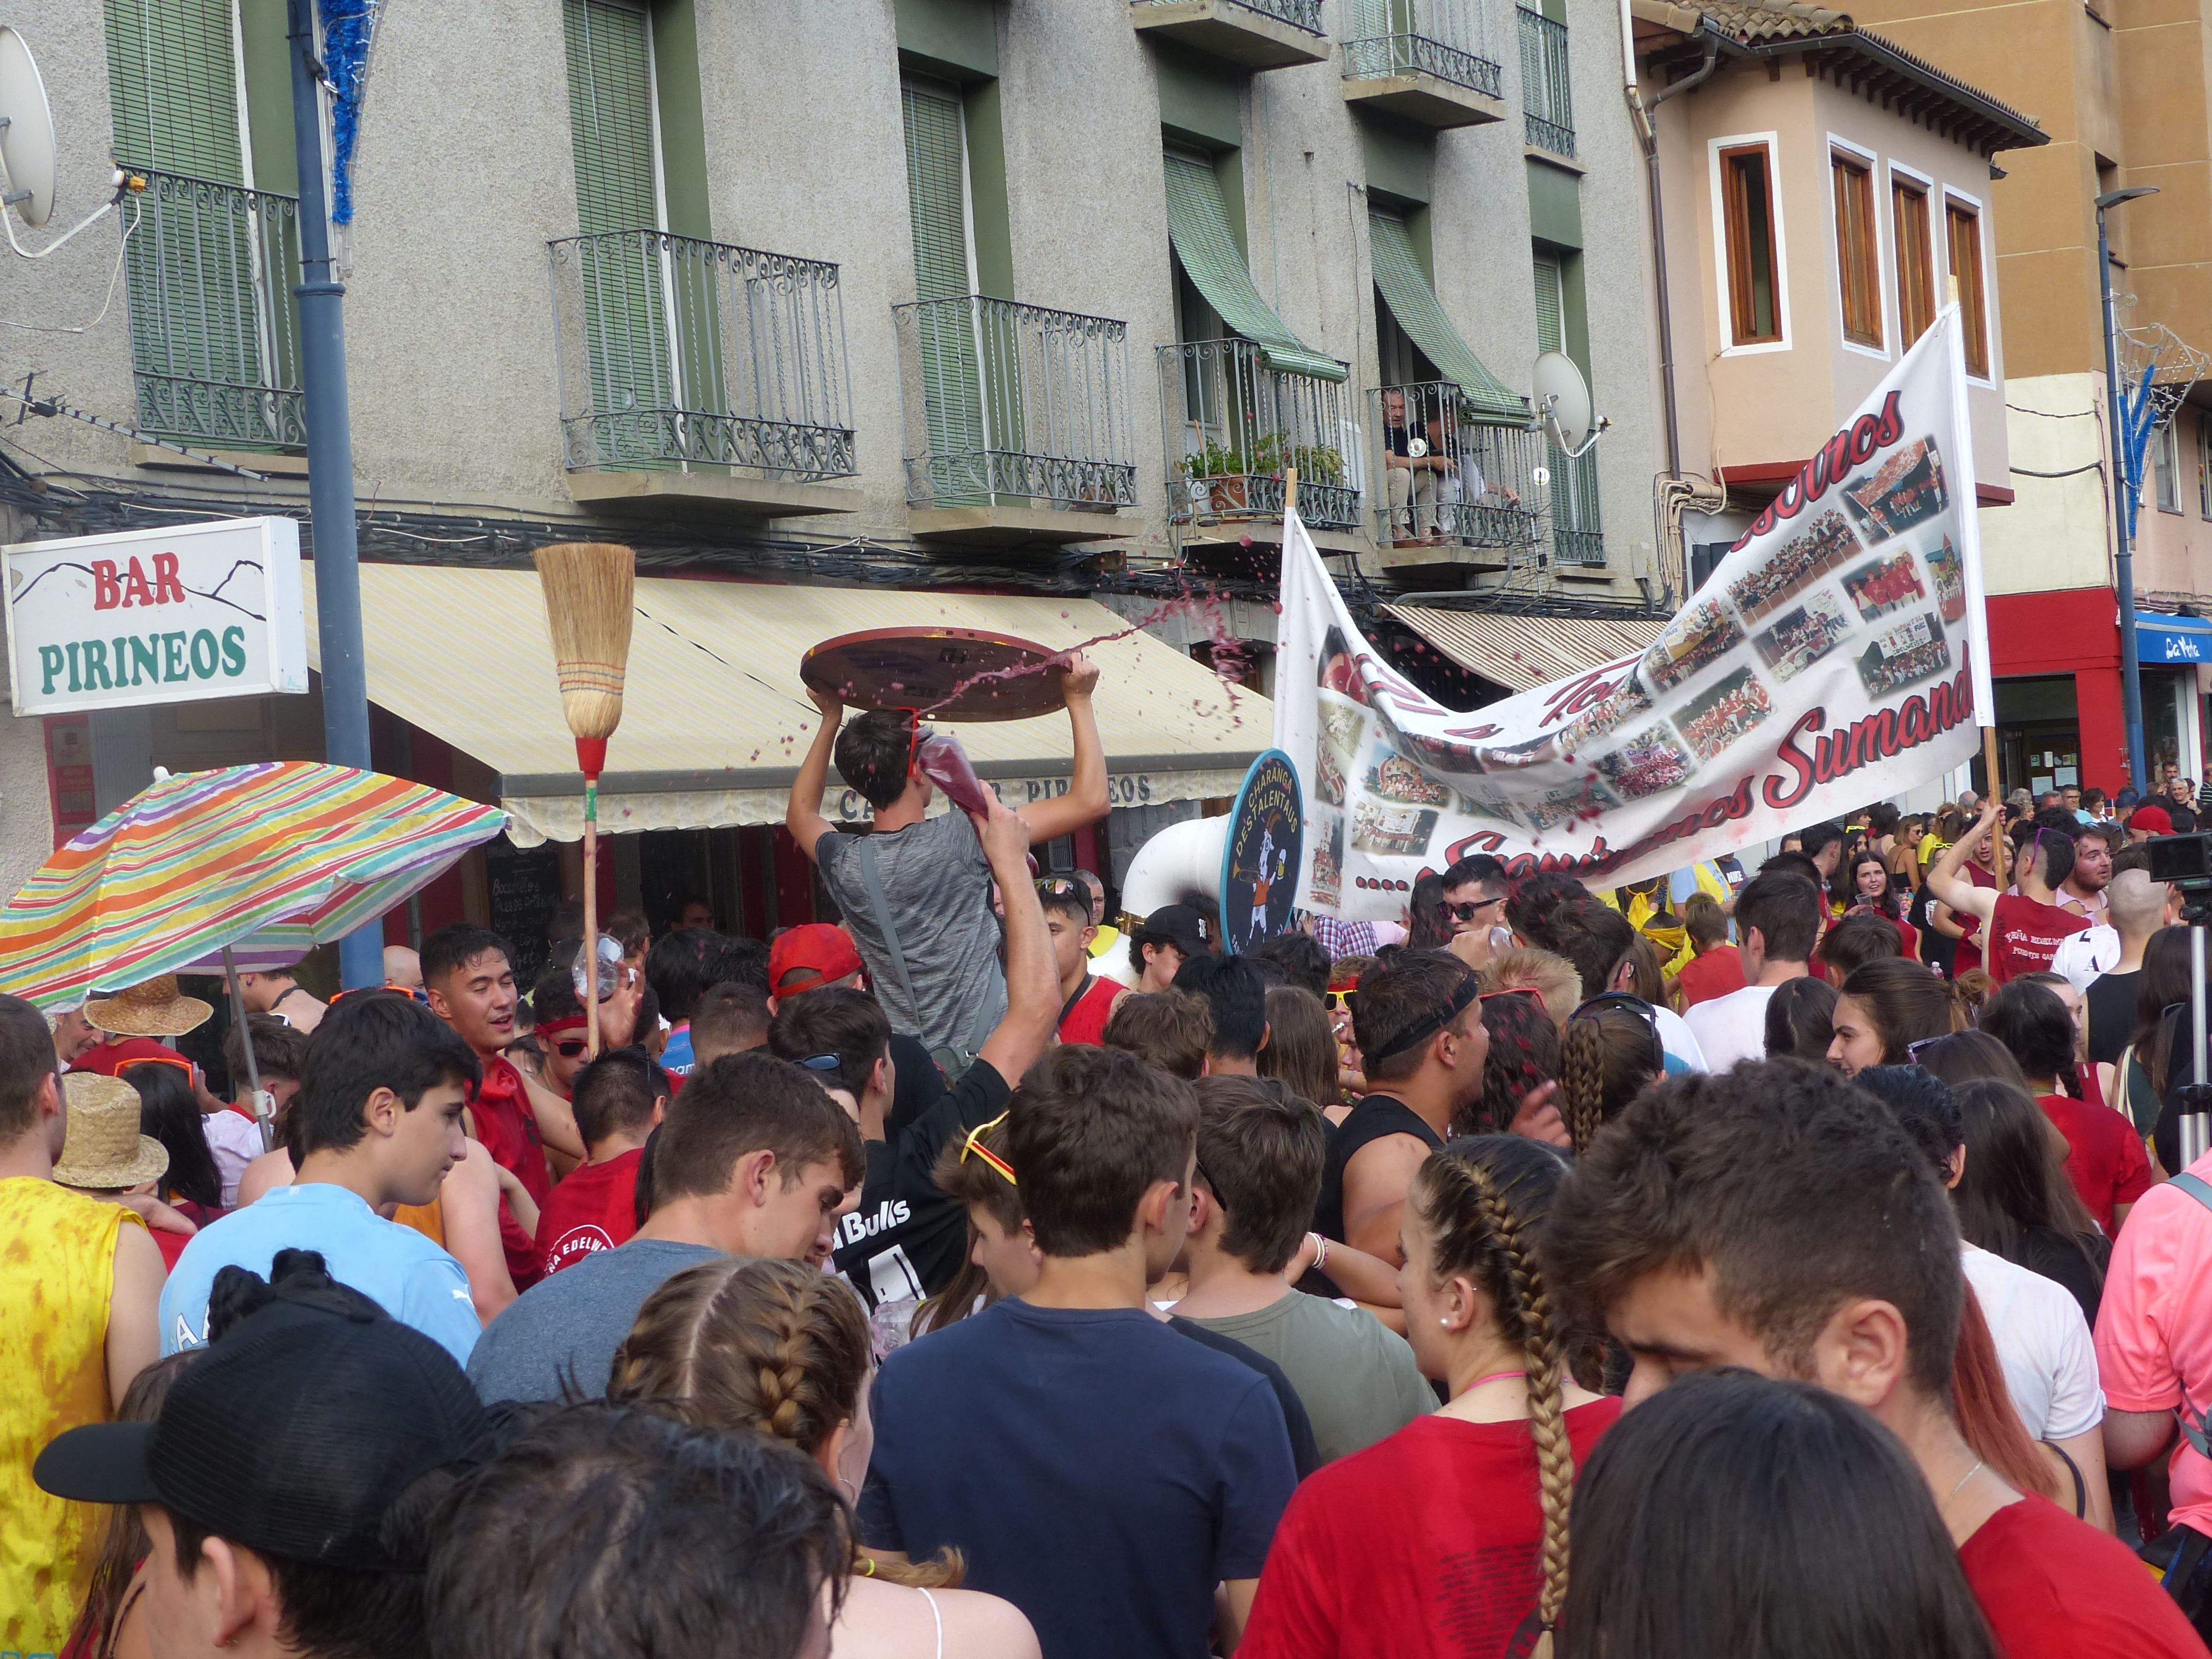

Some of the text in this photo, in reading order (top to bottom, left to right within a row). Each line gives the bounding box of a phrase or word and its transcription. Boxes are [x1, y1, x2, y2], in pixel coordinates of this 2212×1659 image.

[91, 552, 186, 610] BAR
[38, 625, 246, 695] PIRINEOS
[1762, 640, 1974, 809] Sumand
[1026, 775, 1150, 804] PIREOS
[1249, 767, 1292, 808] CHARANGA
[1726, 870, 1744, 884] NIKE
[2005, 930, 2028, 943] PEÑA
[842, 1199, 911, 1245] Bulls
[563, 1237, 608, 1255] EDELW
